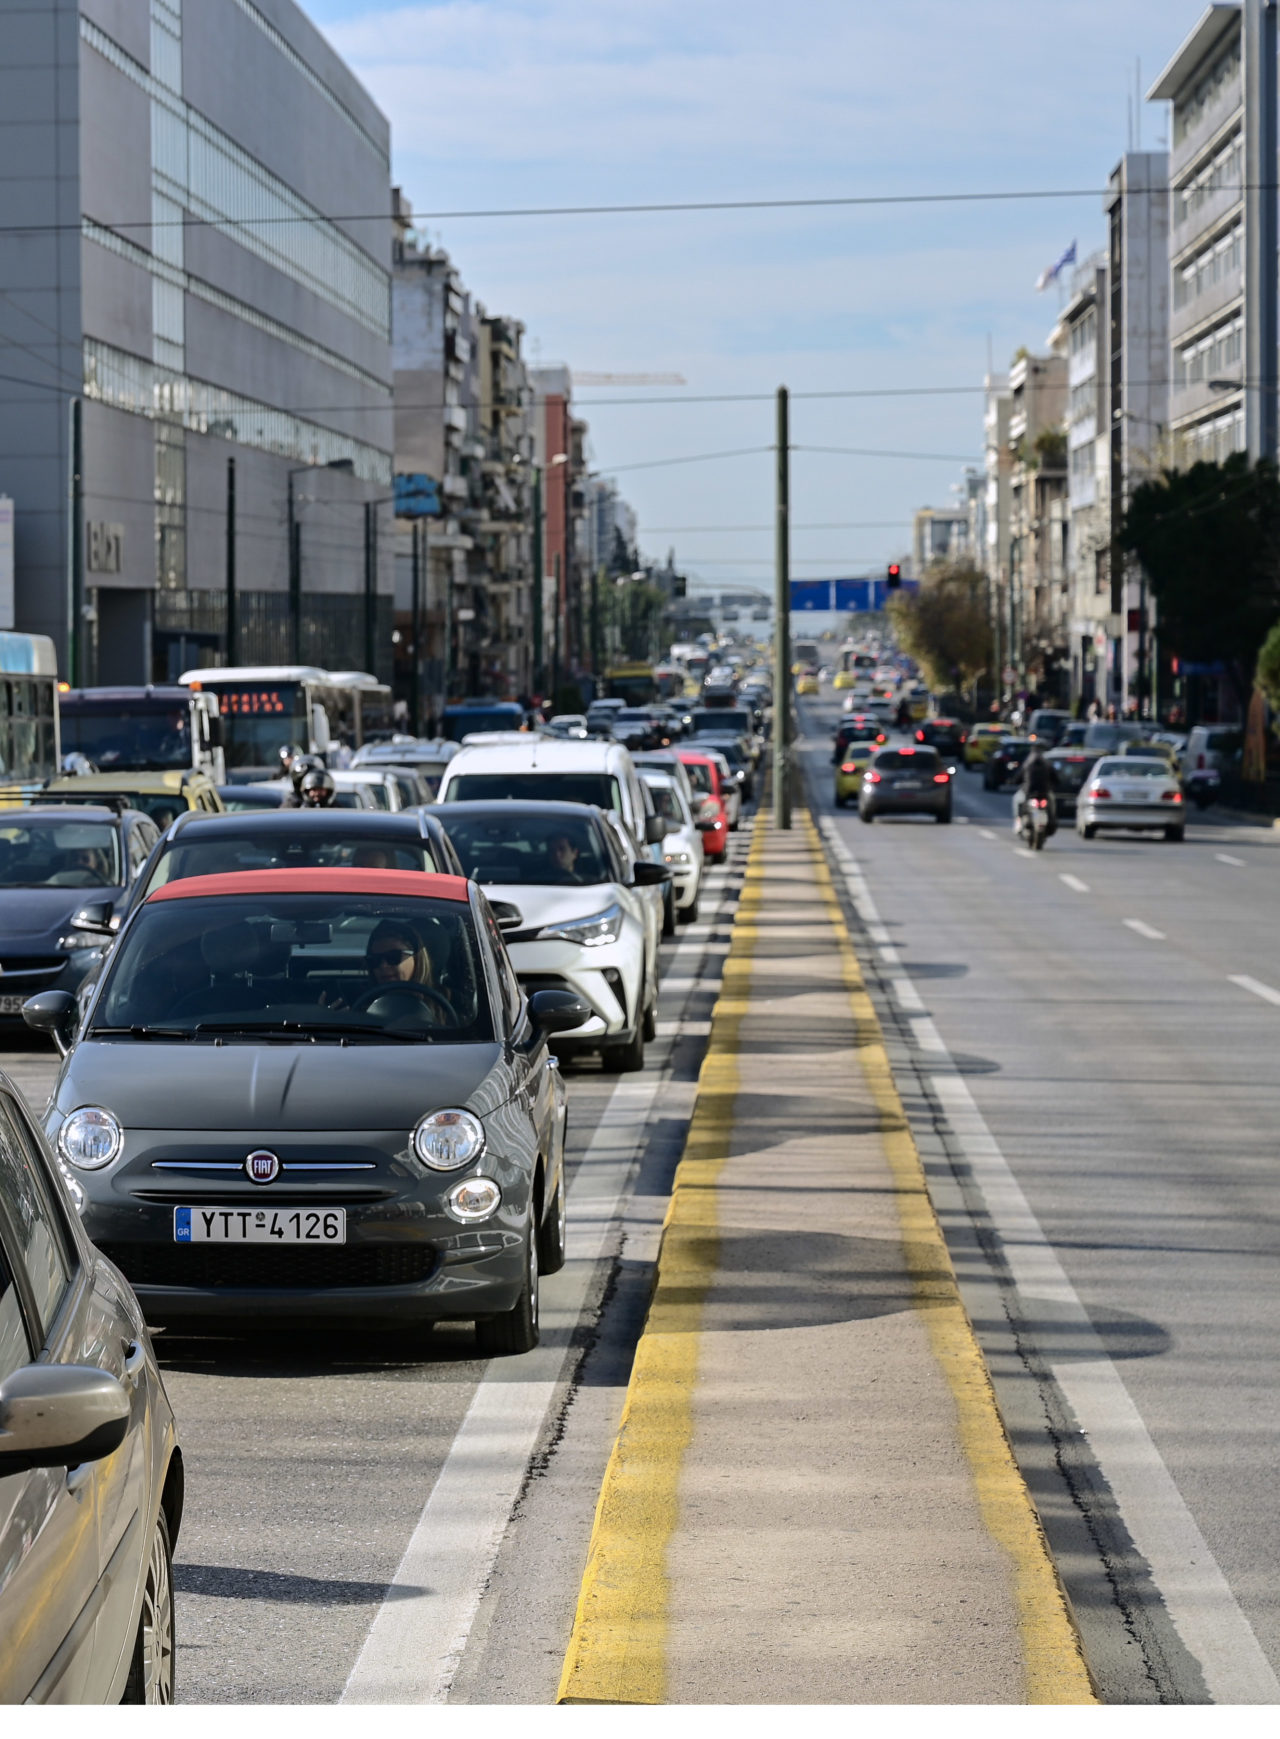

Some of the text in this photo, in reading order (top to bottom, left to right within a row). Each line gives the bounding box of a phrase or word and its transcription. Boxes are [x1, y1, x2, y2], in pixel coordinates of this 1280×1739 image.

[253, 1160, 273, 1174] FIAT
[177, 1211, 339, 1240] GR YTT-4126
